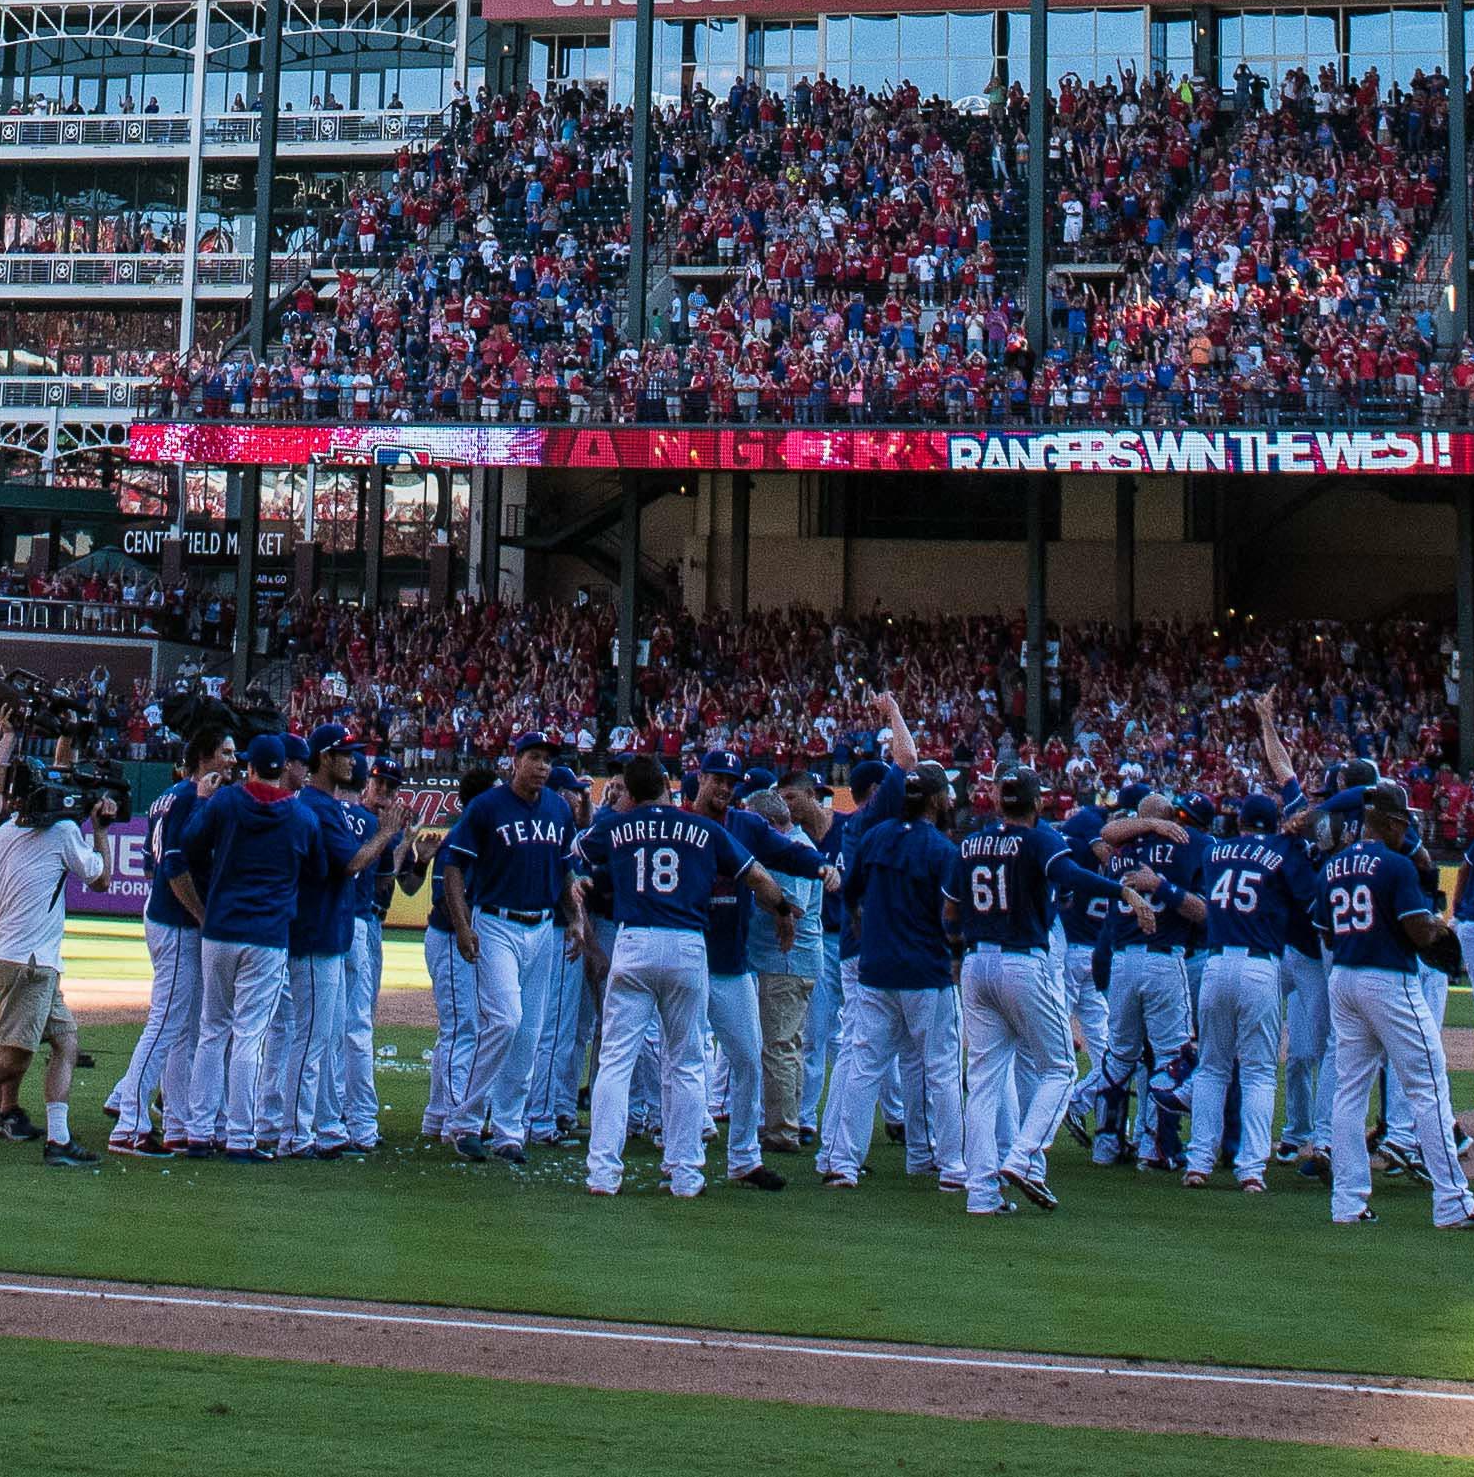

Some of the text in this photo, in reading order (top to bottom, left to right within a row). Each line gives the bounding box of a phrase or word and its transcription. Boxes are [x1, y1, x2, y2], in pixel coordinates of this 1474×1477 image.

[949, 430, 1147, 471] RANGERS
[1229, 431, 1316, 471] THE
[226, 532, 285, 557] MKET
[610, 820, 710, 849] MORELAND
[961, 835, 1023, 860] CHIRINOS
[633, 847, 680, 893] 18
[1211, 843, 1284, 872] HOLLAND
[1326, 854, 1382, 882] BELTRE
[971, 864, 1009, 912] 61
[1210, 868, 1262, 914] 45
[1329, 884, 1374, 934] 29
